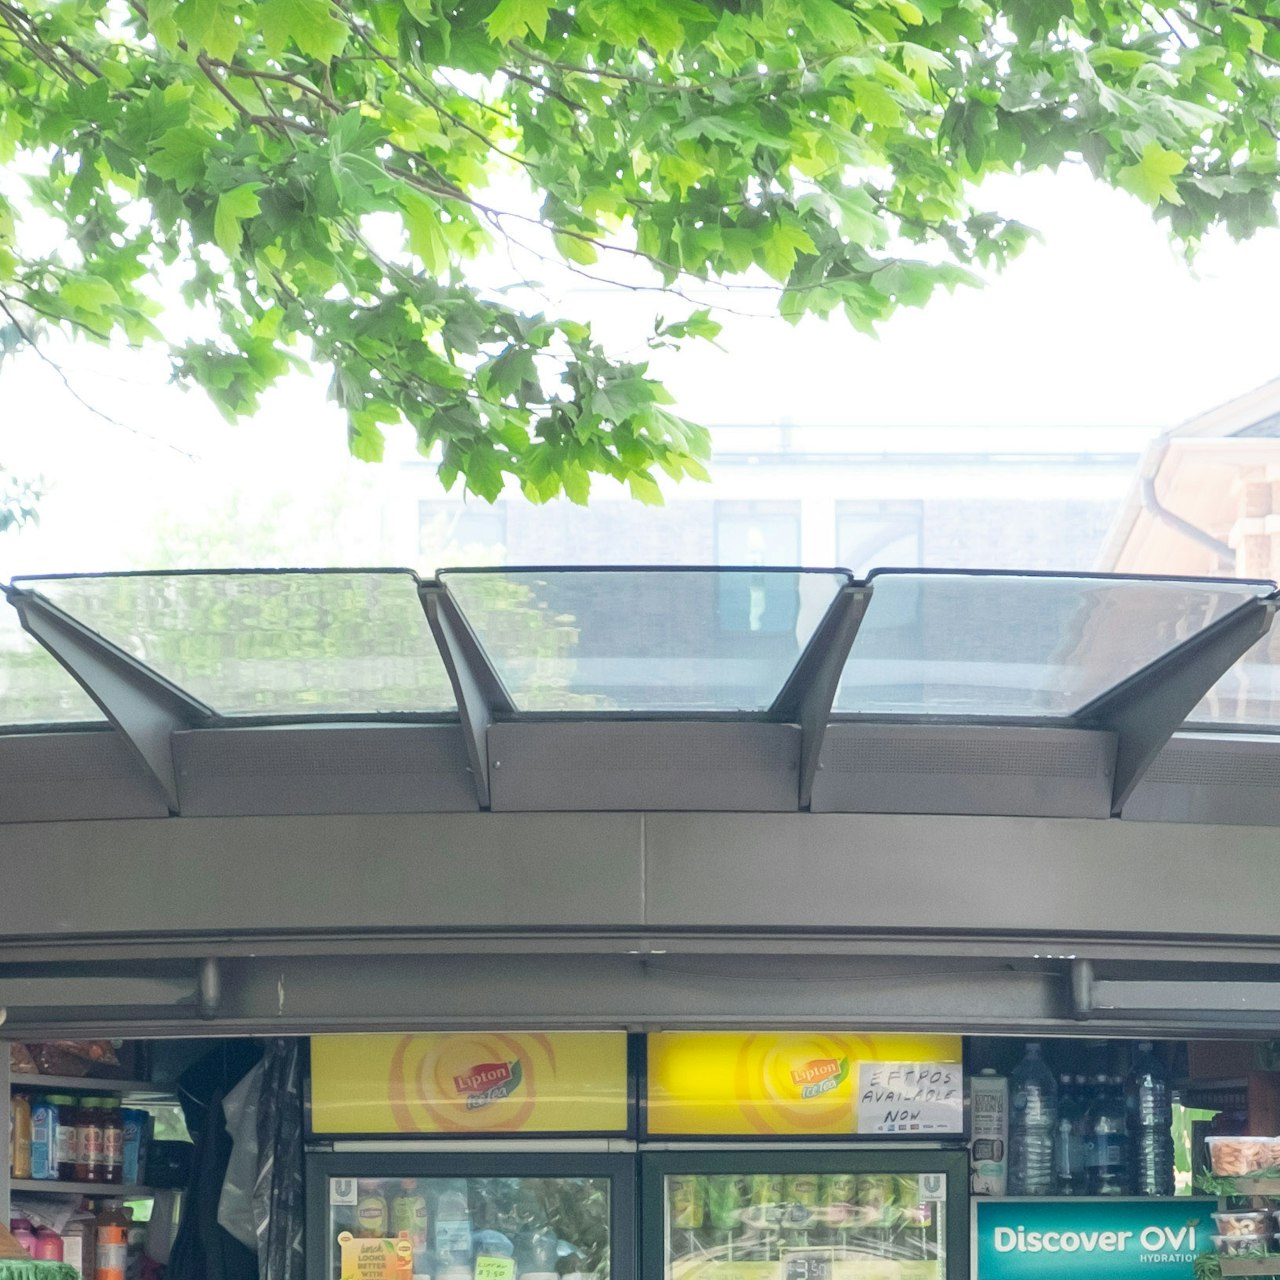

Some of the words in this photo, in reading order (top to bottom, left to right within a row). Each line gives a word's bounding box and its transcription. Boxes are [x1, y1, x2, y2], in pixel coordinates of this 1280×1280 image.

[457, 1067, 508, 1089] Lipton
[793, 1062, 837, 1082] Lipton
[870, 1070, 952, 1087] EFTPOS
[803, 1086, 819, 1098] Ice
[819, 1078, 837, 1092] Tea
[883, 1110, 921, 1123] NOW
[994, 1225, 1133, 1252] Discover
[1140, 1226, 1196, 1251] OVI
